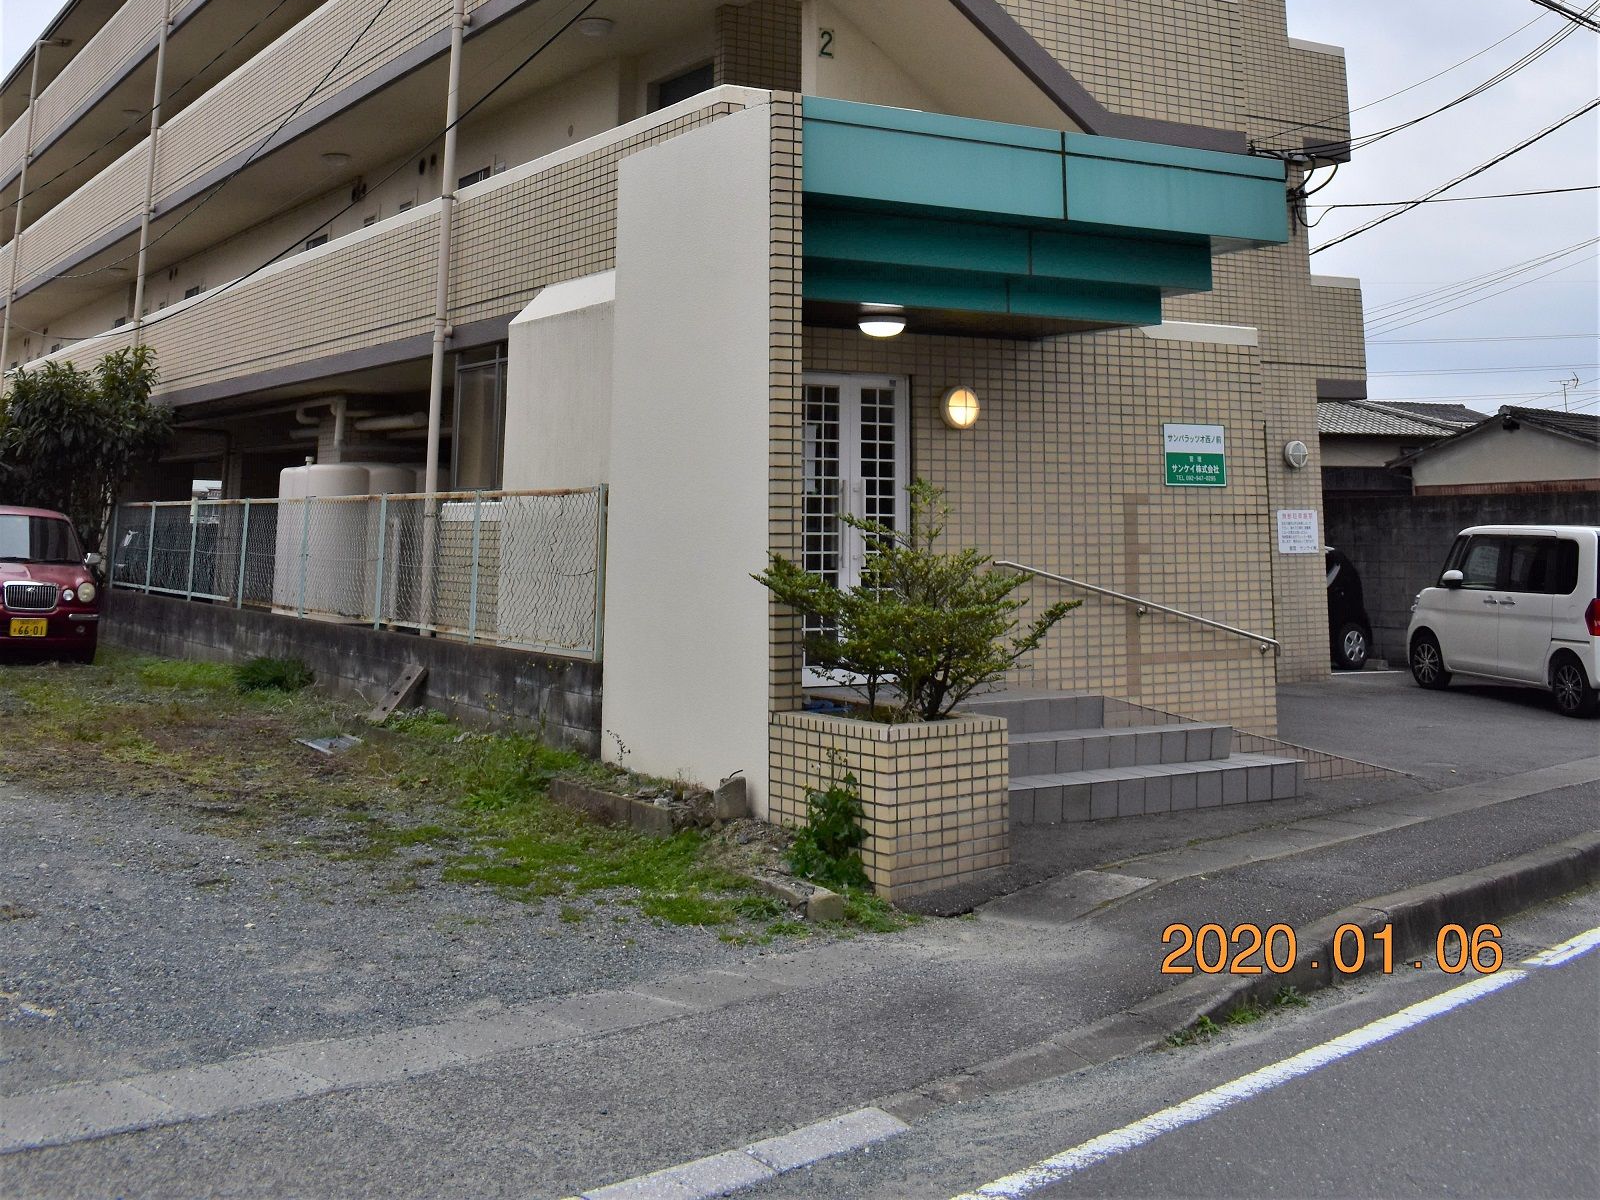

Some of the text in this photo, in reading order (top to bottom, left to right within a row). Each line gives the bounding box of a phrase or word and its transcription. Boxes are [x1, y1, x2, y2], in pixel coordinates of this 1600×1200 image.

[820, 30, 833, 57] 2
[1171, 464, 1220, 474] サンケイ株式会社
